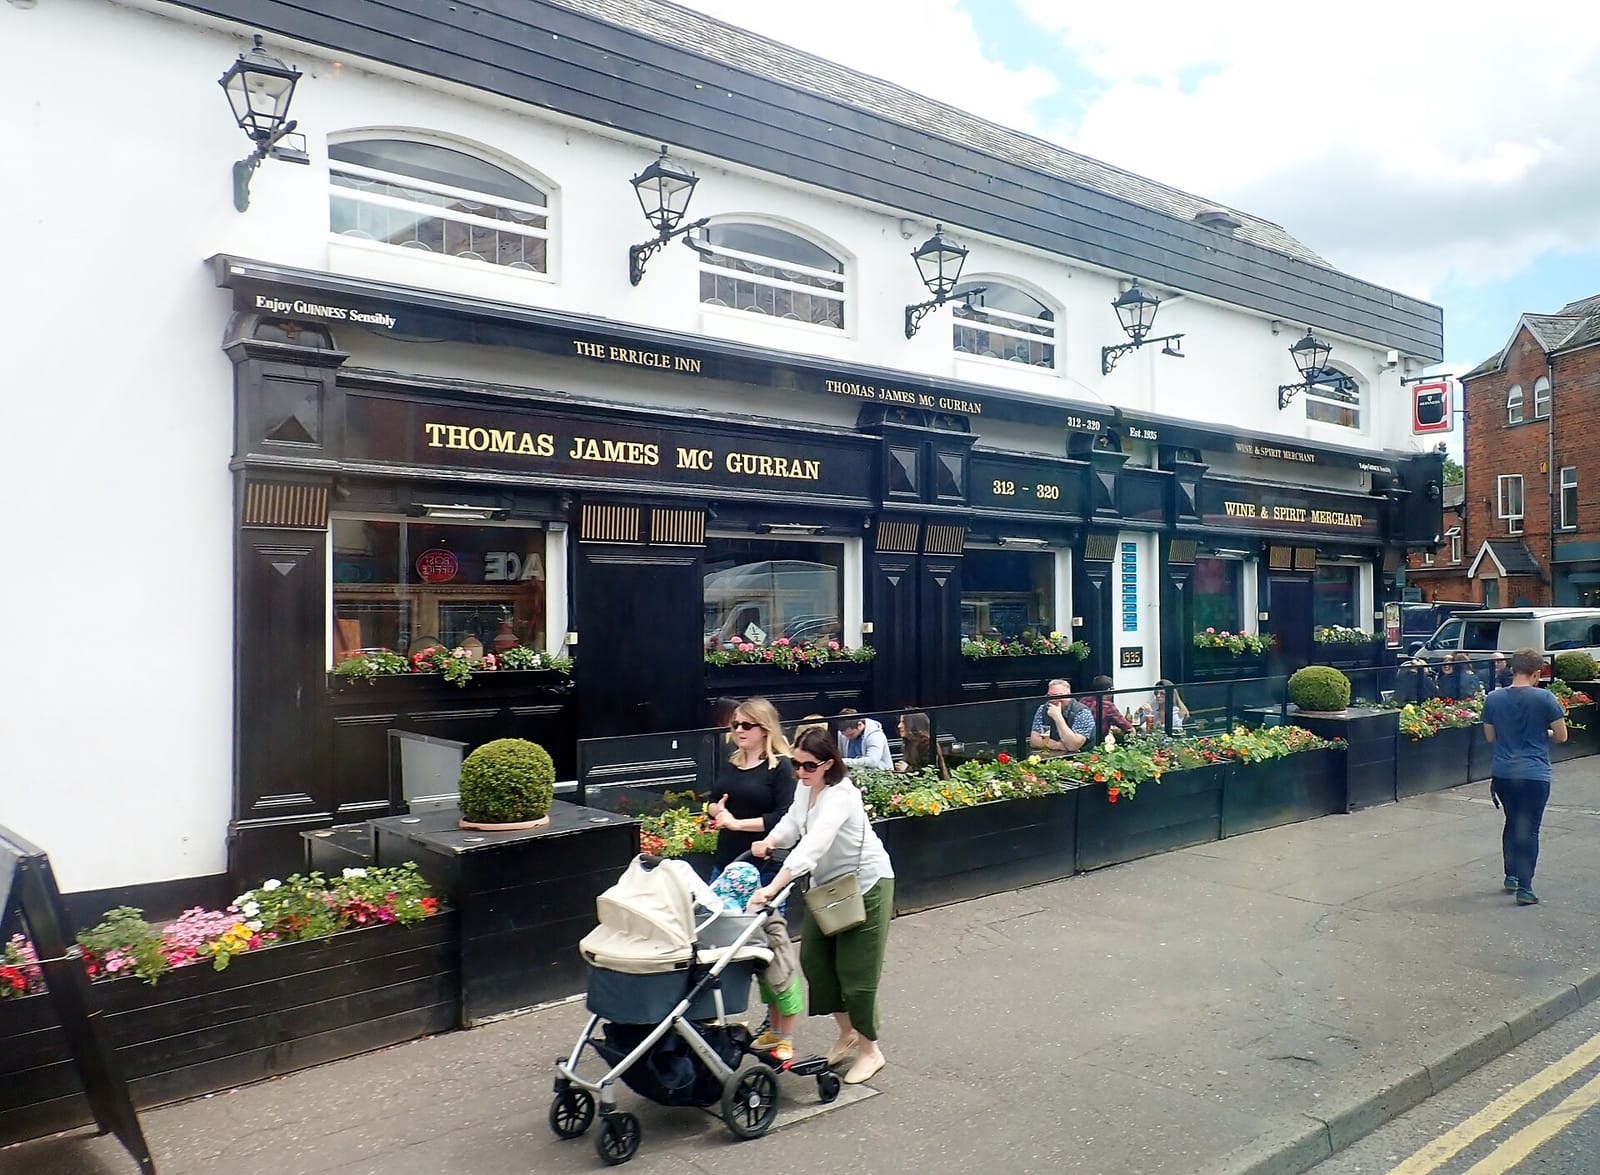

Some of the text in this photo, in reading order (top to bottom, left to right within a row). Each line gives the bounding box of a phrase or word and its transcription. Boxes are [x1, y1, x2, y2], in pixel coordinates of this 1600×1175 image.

[256, 295, 396, 328] Enjoy GUINNESS Sensibly
[573, 340, 701, 373] THE ERRIGLE INN
[826, 380, 982, 414] THOMAS JAMES MC GURRAN
[425, 423, 820, 480] THOMAS JAMES MC GURRAN
[1235, 442, 1253, 454] WINE
[1260, 447, 1282, 458] SPIRIT
[1282, 450, 1315, 463] MERCHANT
[992, 480, 1015, 496] 312
[1036, 484, 1059, 499] 320
[1224, 501, 1363, 527] WINE & SPIRIT MERCHANT
